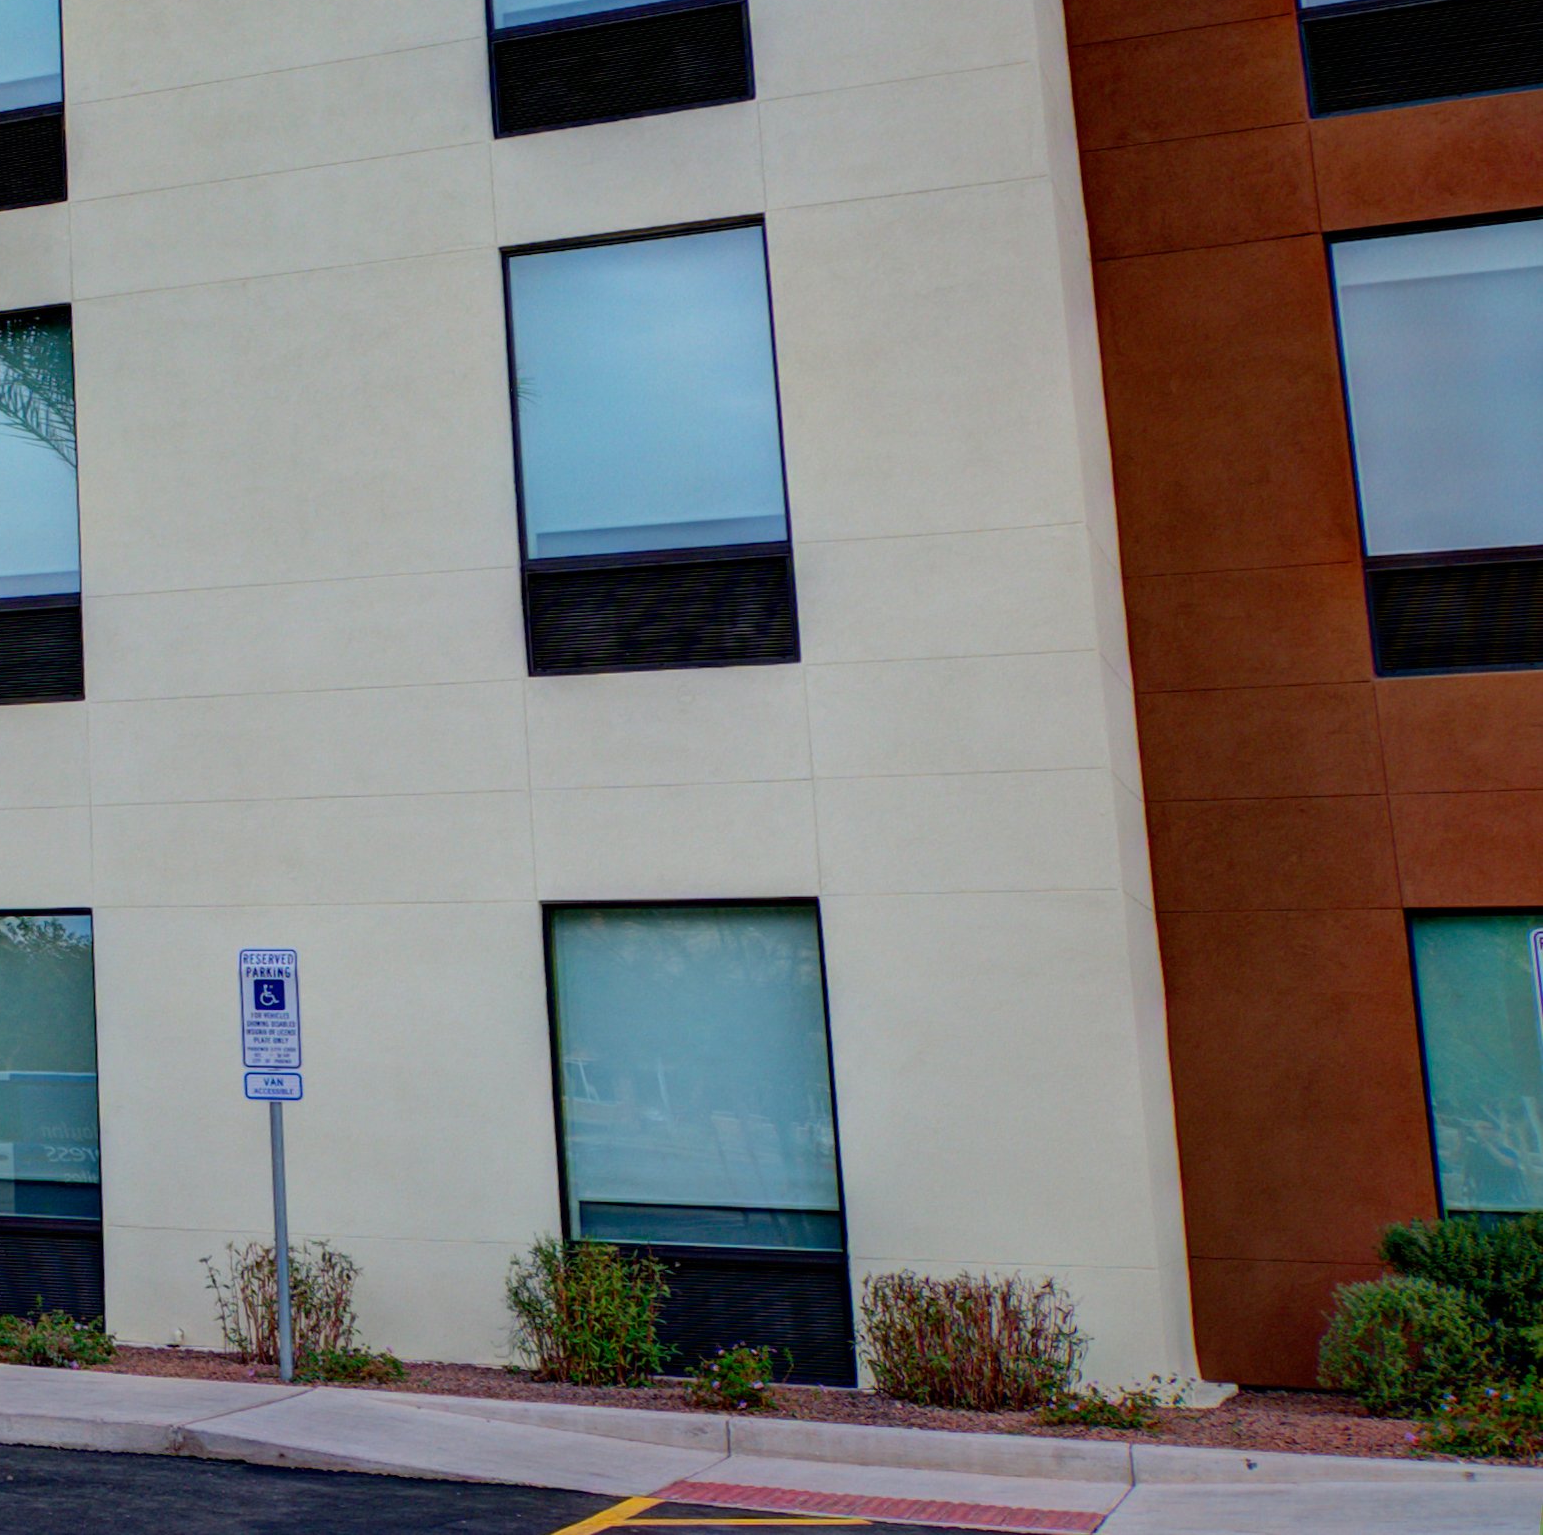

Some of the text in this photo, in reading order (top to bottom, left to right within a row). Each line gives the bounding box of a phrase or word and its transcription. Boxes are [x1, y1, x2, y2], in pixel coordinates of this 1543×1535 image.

[243, 953, 294, 965] RESERVED
[246, 966, 291, 978] PARKING
[263, 1077, 284, 1086] VAN
